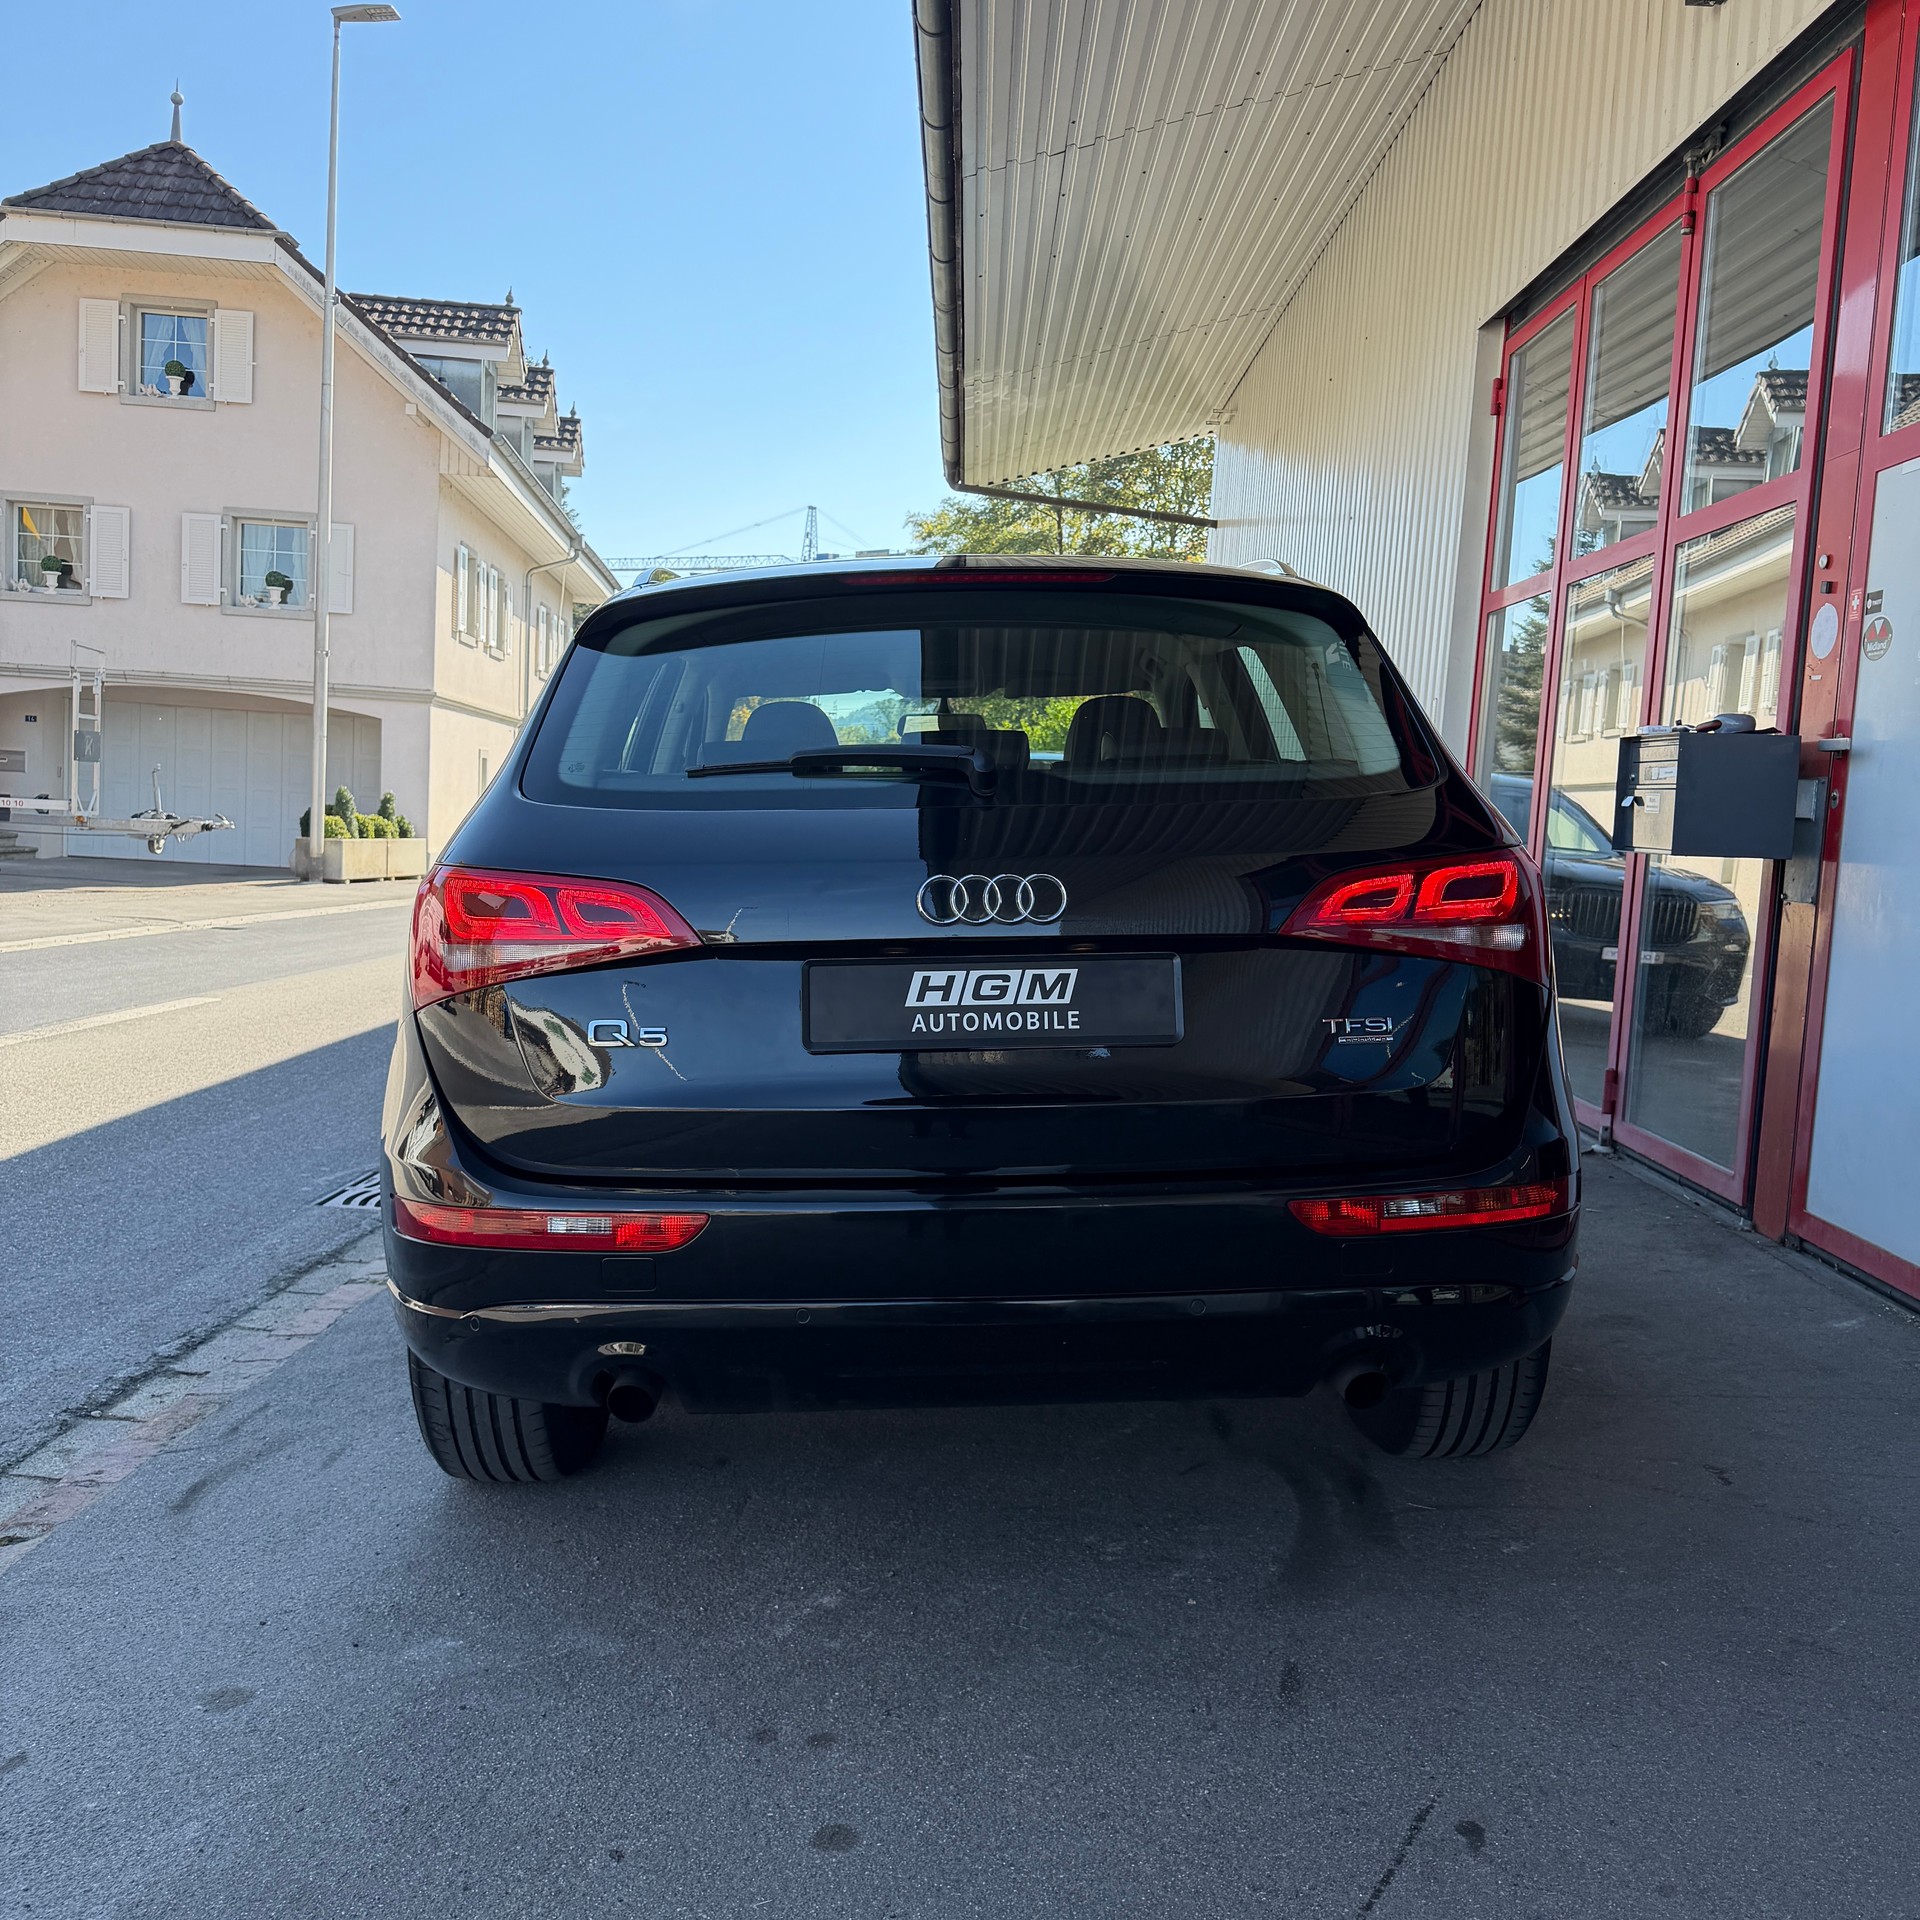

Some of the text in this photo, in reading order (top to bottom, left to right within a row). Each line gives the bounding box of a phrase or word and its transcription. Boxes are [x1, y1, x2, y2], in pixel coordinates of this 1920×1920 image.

[905, 969, 1078, 1007] HGM
[587, 1019, 668, 1047] Q5
[911, 1010, 1080, 1033] AUTOMOBILE
[1322, 1017, 1393, 1034] TFSI
